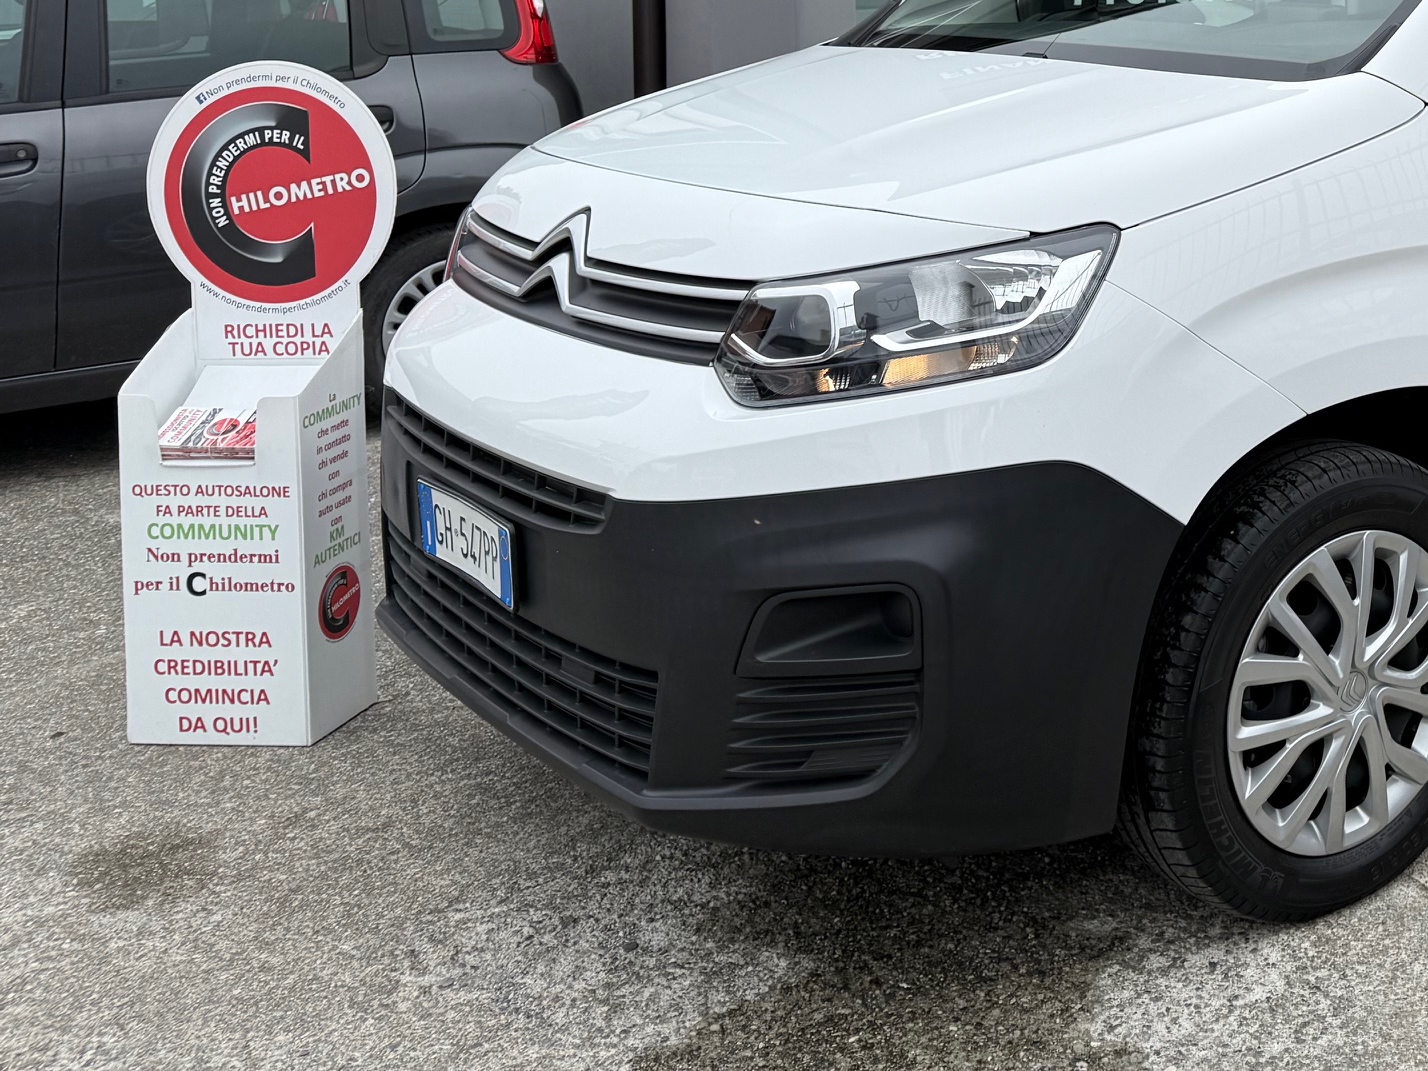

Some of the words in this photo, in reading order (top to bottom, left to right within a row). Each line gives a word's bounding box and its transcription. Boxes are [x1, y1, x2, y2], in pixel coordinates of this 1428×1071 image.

[205, 85, 225, 99] Non
[225, 73, 273, 91] prendermi
[274, 74, 291, 84] per
[292, 75, 300, 85] il
[300, 77, 346, 110] Chilometro
[264, 129, 290, 144] PER
[293, 133, 305, 150] IL
[208, 131, 261, 194] PRENDERMI
[208, 197, 229, 229] NON
[199, 278, 352, 316] www.nonprendermiperilchilometro.it
[224, 323, 305, 339] RICHIEDI
[310, 323, 334, 339] LA
[229, 341, 267, 357] TUA
[272, 341, 331, 357] COPIA
[328, 393, 336, 403] La
[303, 392, 362, 429] COMMUNITY
[317, 427, 330, 439] che
[330, 418, 349, 433] mette
[316, 445, 324, 456] in
[324, 433, 352, 452] contatto
[318, 457, 328, 471] chi
[328, 449, 349, 466] vende
[328, 469, 340, 481] con
[131, 483, 191, 499] QUESTO
[194, 484, 291, 499] AUTOSALONE
[317, 489, 328, 502] chi
[328, 478, 353, 497] compra
[155, 504, 174, 518] FA
[177, 505, 221, 518] PARTE
[225, 505, 269, 519] DELLA
[318, 504, 333, 518] auto
[334, 494, 352, 510] usate
[147, 521, 280, 542] COMMUNITY
[330, 515, 342, 527] con
[433, 504, 454, 553] GH
[329, 523, 345, 544] KM
[146, 547, 182, 564] Non
[187, 546, 281, 568] prendermi
[313, 530, 361, 569] AUTENTICI
[133, 578, 163, 596] per
[167, 576, 182, 592] il
[186, 571, 296, 597] Chilometro
[159, 630, 184, 648] LA
[189, 630, 273, 649] NOSTRA
[164, 687, 271, 706] COMINCIA
[178, 716, 207, 734] DA
[212, 716, 259, 736] QUI!
